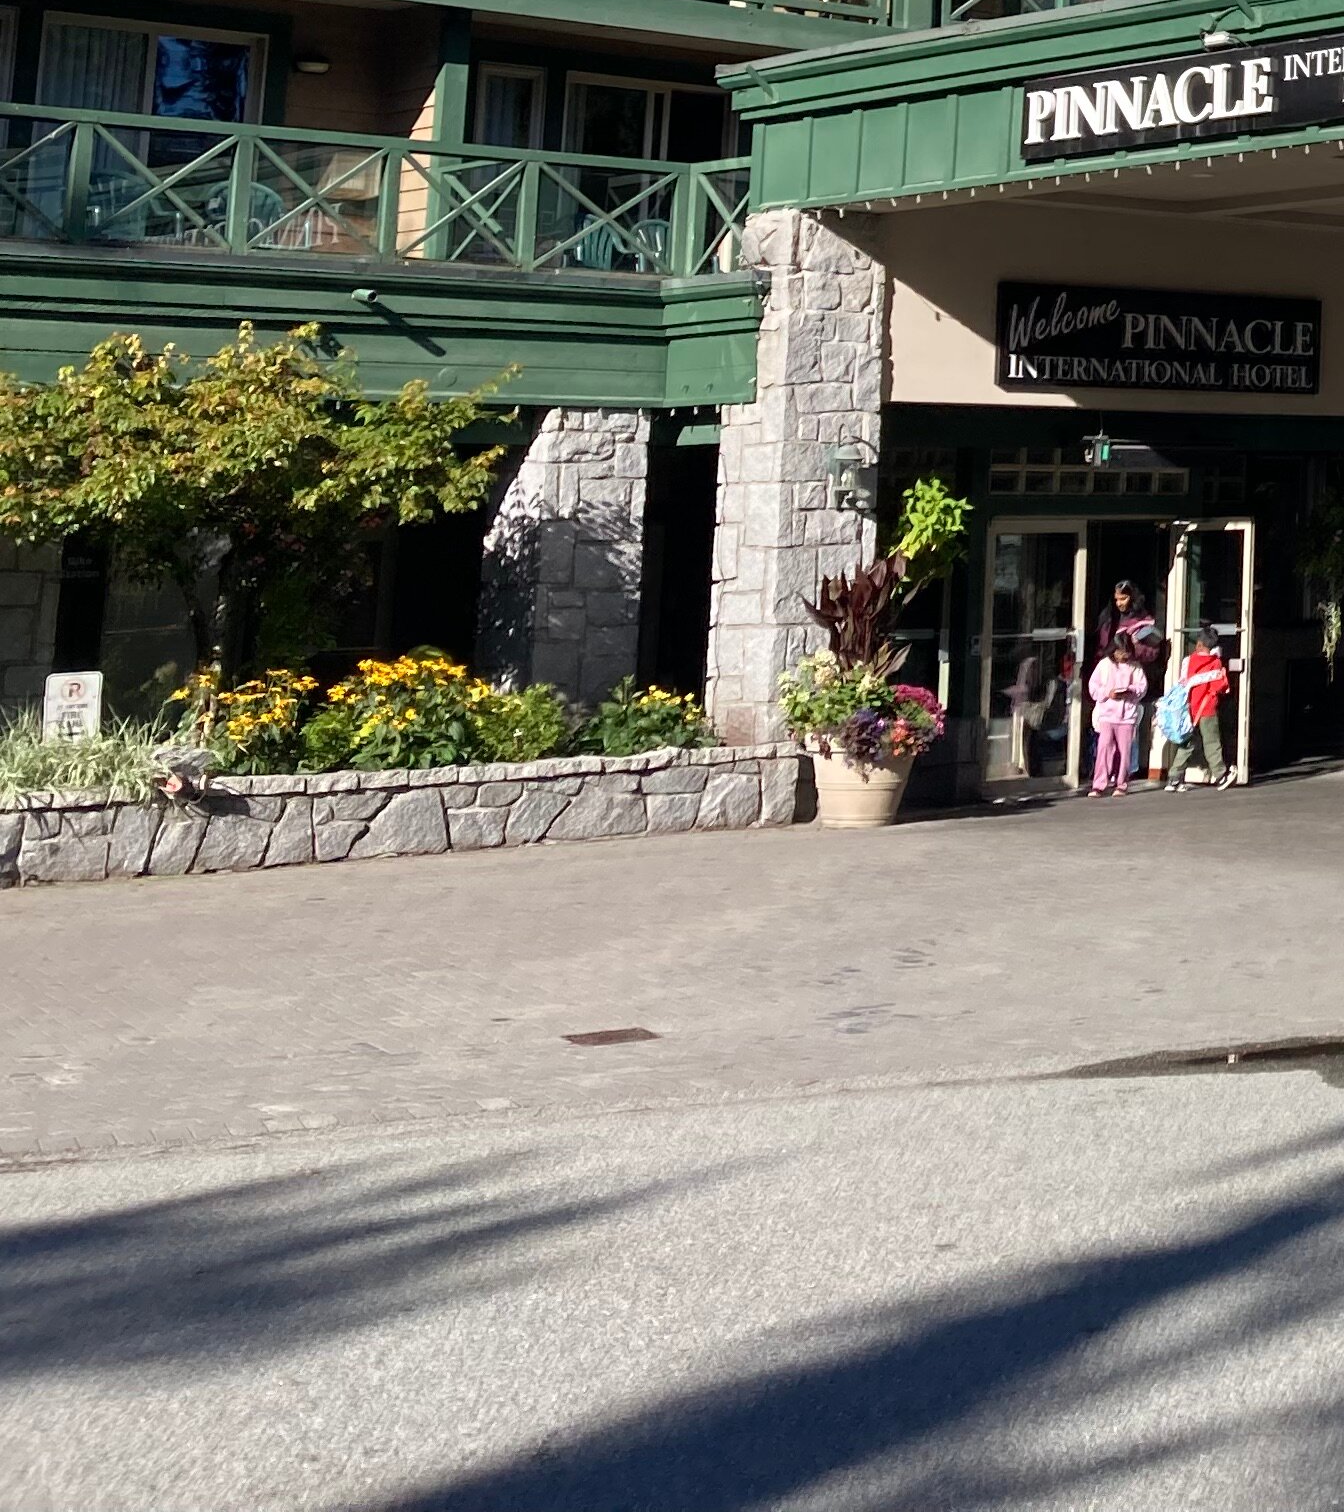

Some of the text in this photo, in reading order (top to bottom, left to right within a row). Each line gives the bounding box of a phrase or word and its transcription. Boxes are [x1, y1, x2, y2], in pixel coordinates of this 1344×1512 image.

[1023, 56, 1276, 145] PINNACLE
[1008, 291, 1315, 356] Welcome PINNACLE
[1007, 353, 1314, 390] INTERNATIONAL HOTEL
